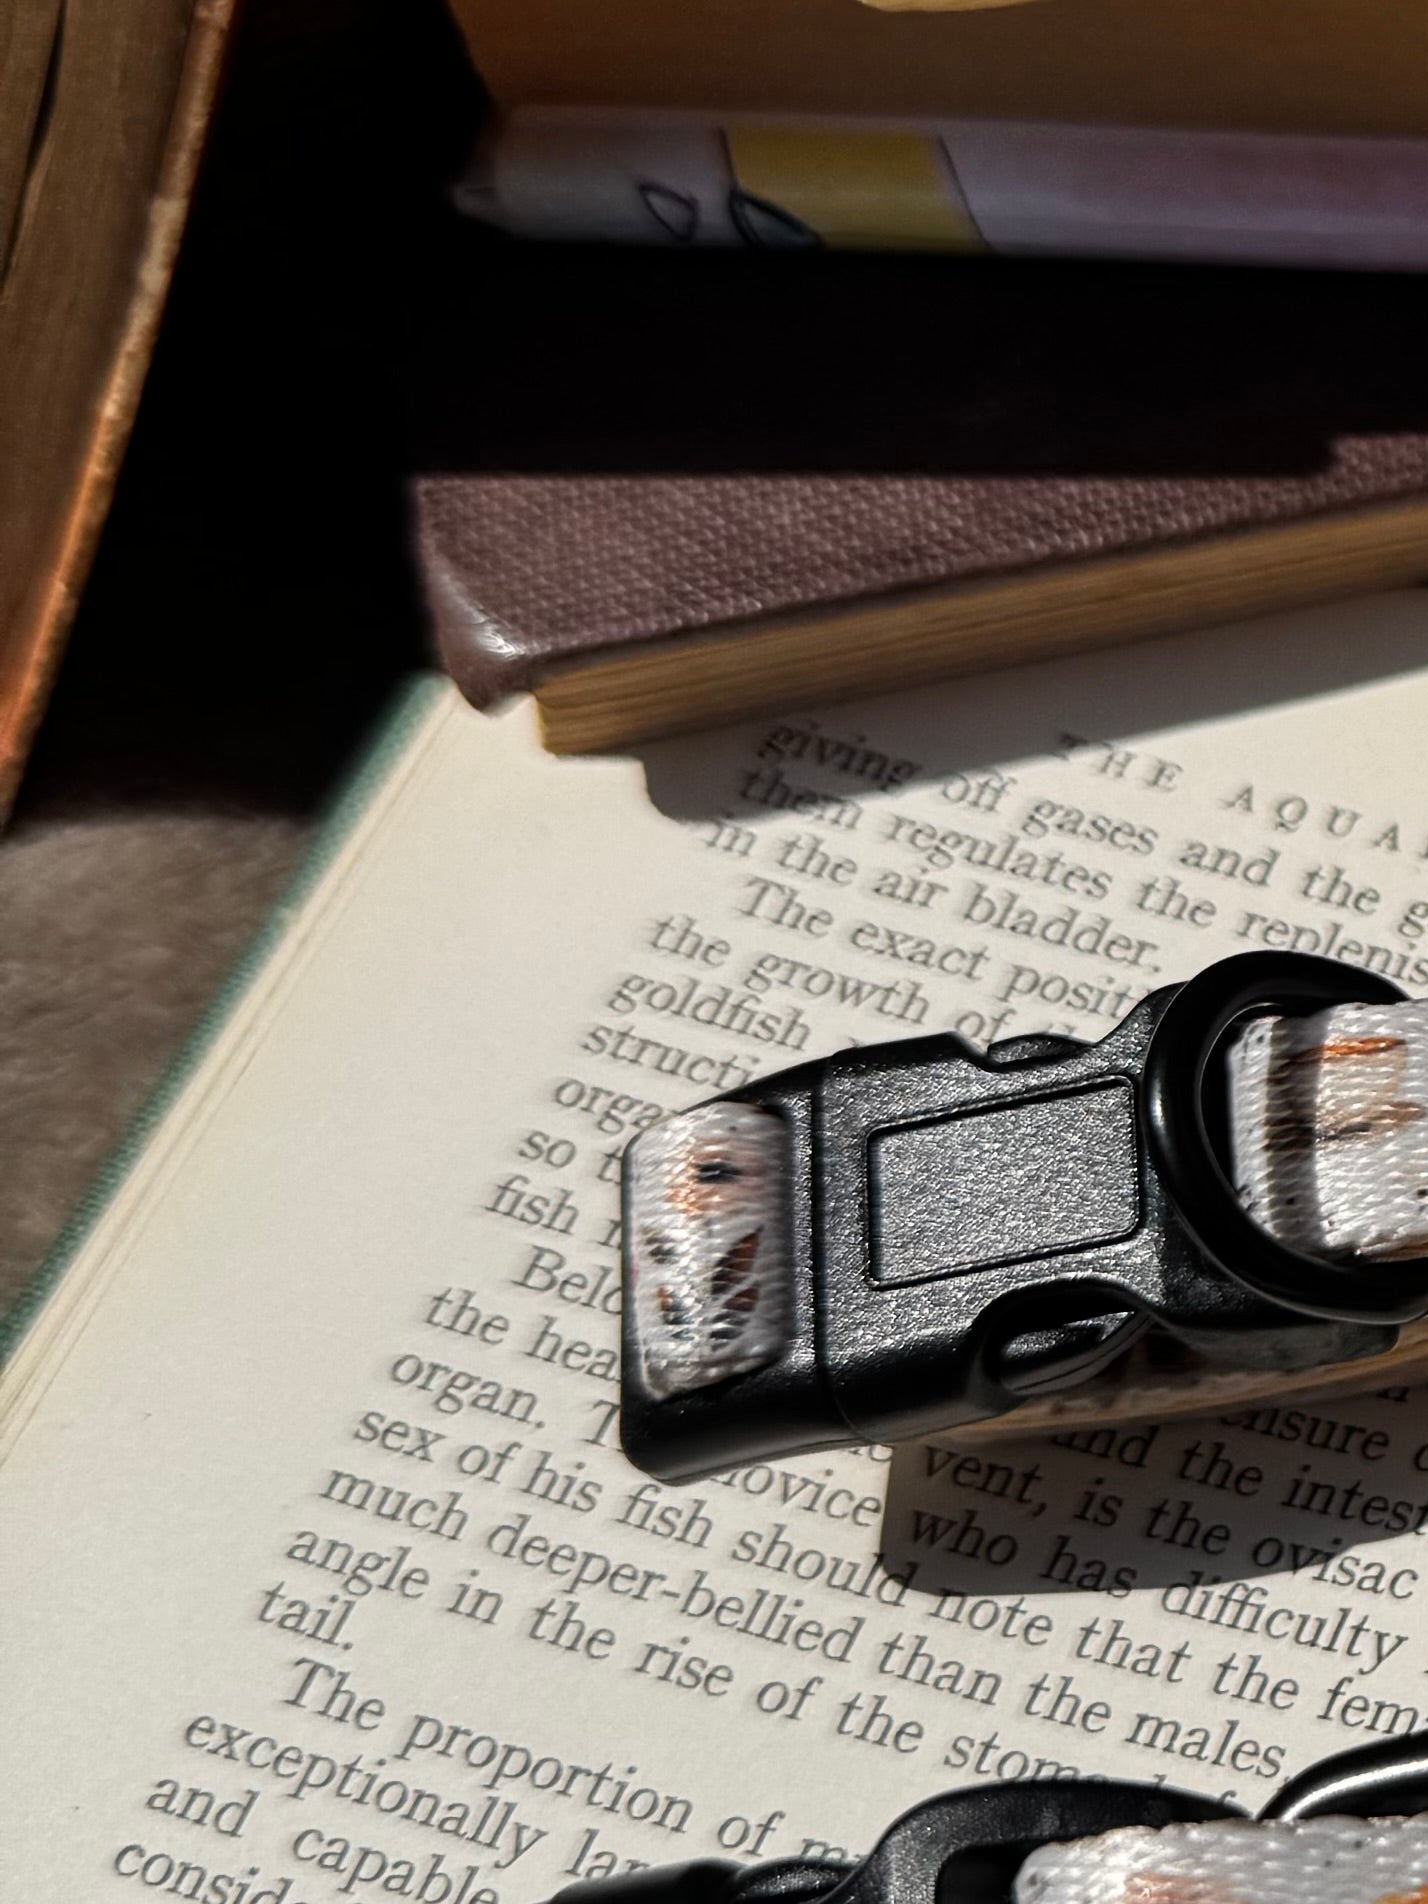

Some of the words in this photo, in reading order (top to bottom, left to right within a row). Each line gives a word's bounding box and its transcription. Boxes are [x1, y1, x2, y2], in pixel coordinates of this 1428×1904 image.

[1052, 730, 1183, 792] THE
[1021, 801, 1157, 850] gases
[1179, 844, 1279, 886] and
[1302, 867, 1379, 913] the
[651, 918, 729, 964] the
[744, 955, 928, 1024] growth
[742, 878, 832, 934] The
[851, 924, 989, 979] exact
[873, 873, 948, 907] air
[963, 884, 1161, 972] bladder.
[608, 975, 809, 1050] goldfish
[392, 1355, 543, 1428] organ.
[353, 1412, 445, 1462] sex
[457, 1442, 522, 1482] of
[520, 1451, 602, 1512] his
[615, 1484, 712, 1547] fish
[258, 1582, 355, 1650] tail.
[286, 1532, 429, 1598] angle
[446, 1570, 502, 1624] in
[529, 1599, 615, 1659] the
[633, 1637, 733, 1696] rise
[756, 1677, 823, 1720] of
[837, 1693, 923, 1753] the
[319, 1471, 467, 1540] much
[487, 1514, 865, 1663] deeper-bellied
[878, 1632, 1001, 1705] than
[1024, 1674, 1111, 1733] the
[1124, 1714, 1285, 1778] males
[1160, 1571, 1408, 1675] difficulty
[145, 1779, 259, 1837] and
[184, 1716, 548, 1869] exceptionally
[283, 1658, 384, 1730] The
[393, 1715, 692, 1833] proportion
[716, 1808, 784, 1856] of
